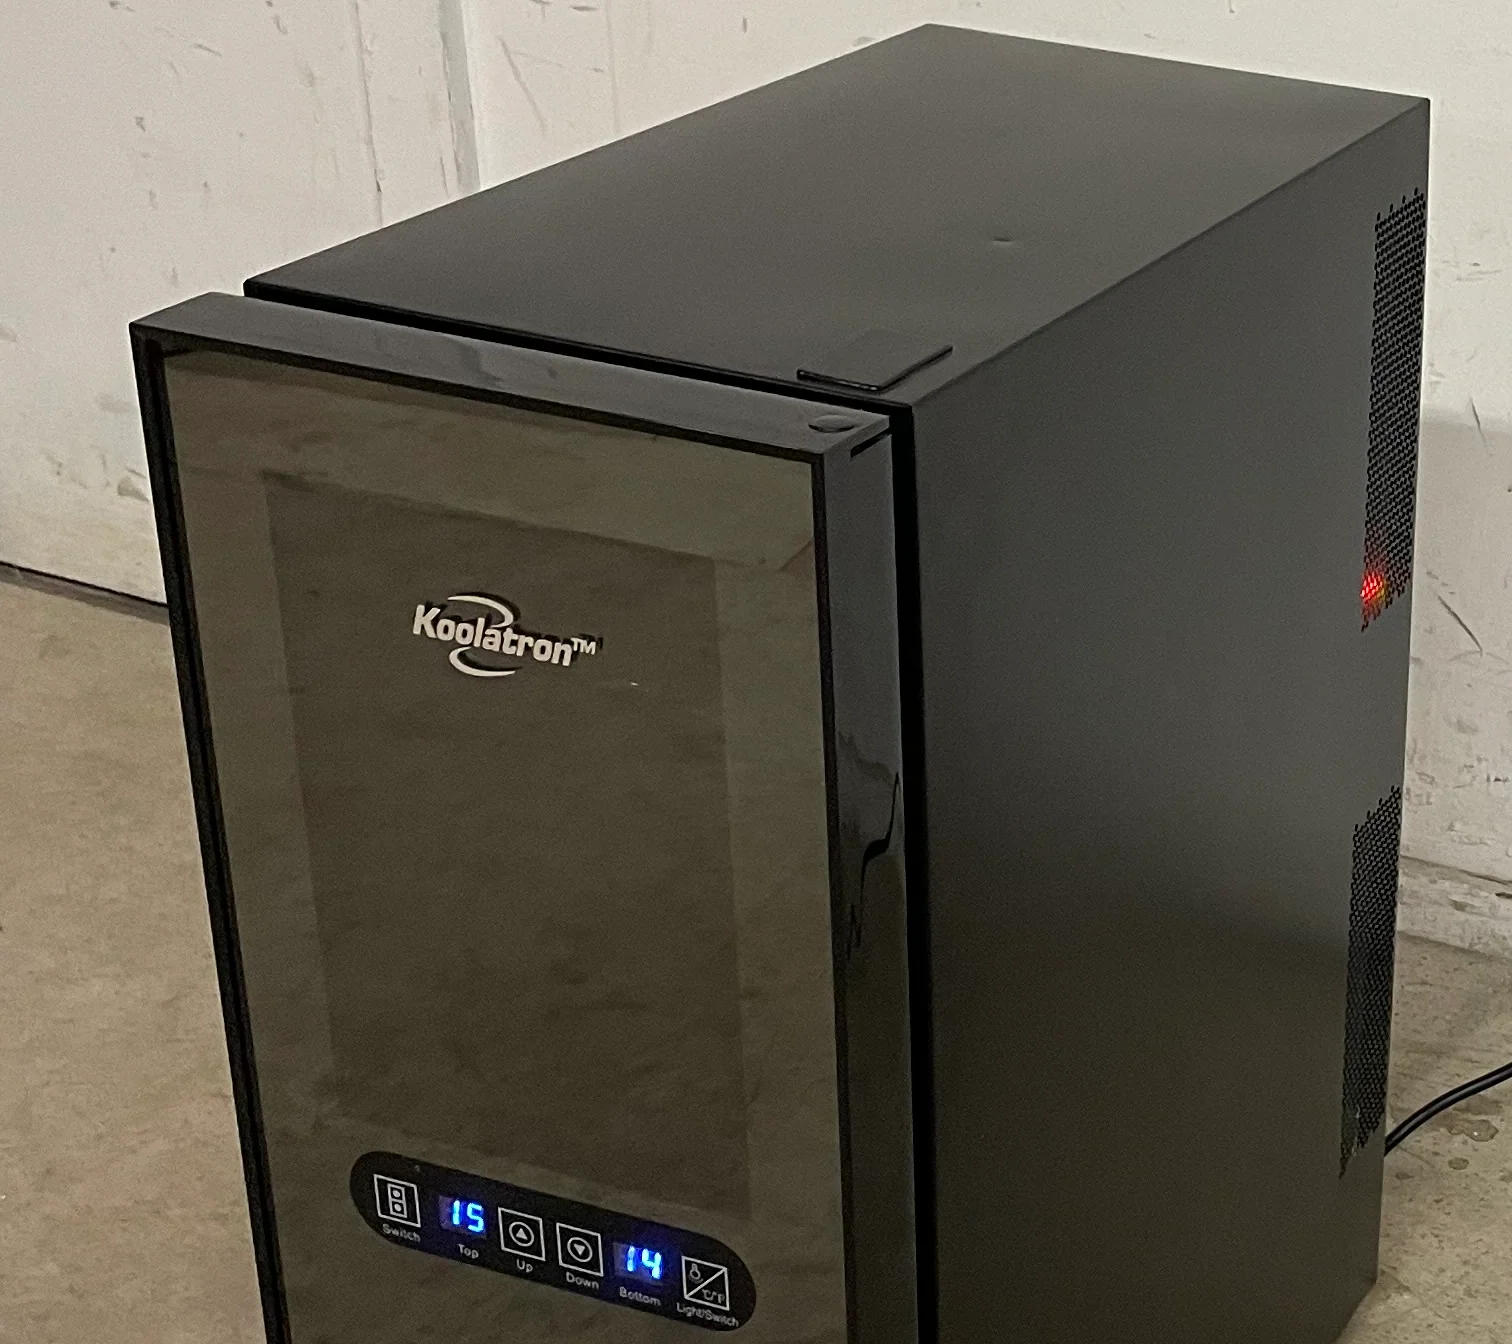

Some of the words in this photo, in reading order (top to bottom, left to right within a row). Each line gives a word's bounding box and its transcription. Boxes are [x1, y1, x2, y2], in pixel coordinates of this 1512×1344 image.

[452, 1198, 485, 1233] 15
[382, 1223, 421, 1243] Switch
[457, 1243, 479, 1259] Top
[516, 1258, 533, 1273] Up
[627, 1245, 662, 1280] 14
[566, 1271, 600, 1289] Down
[619, 1286, 661, 1306] Bottom
